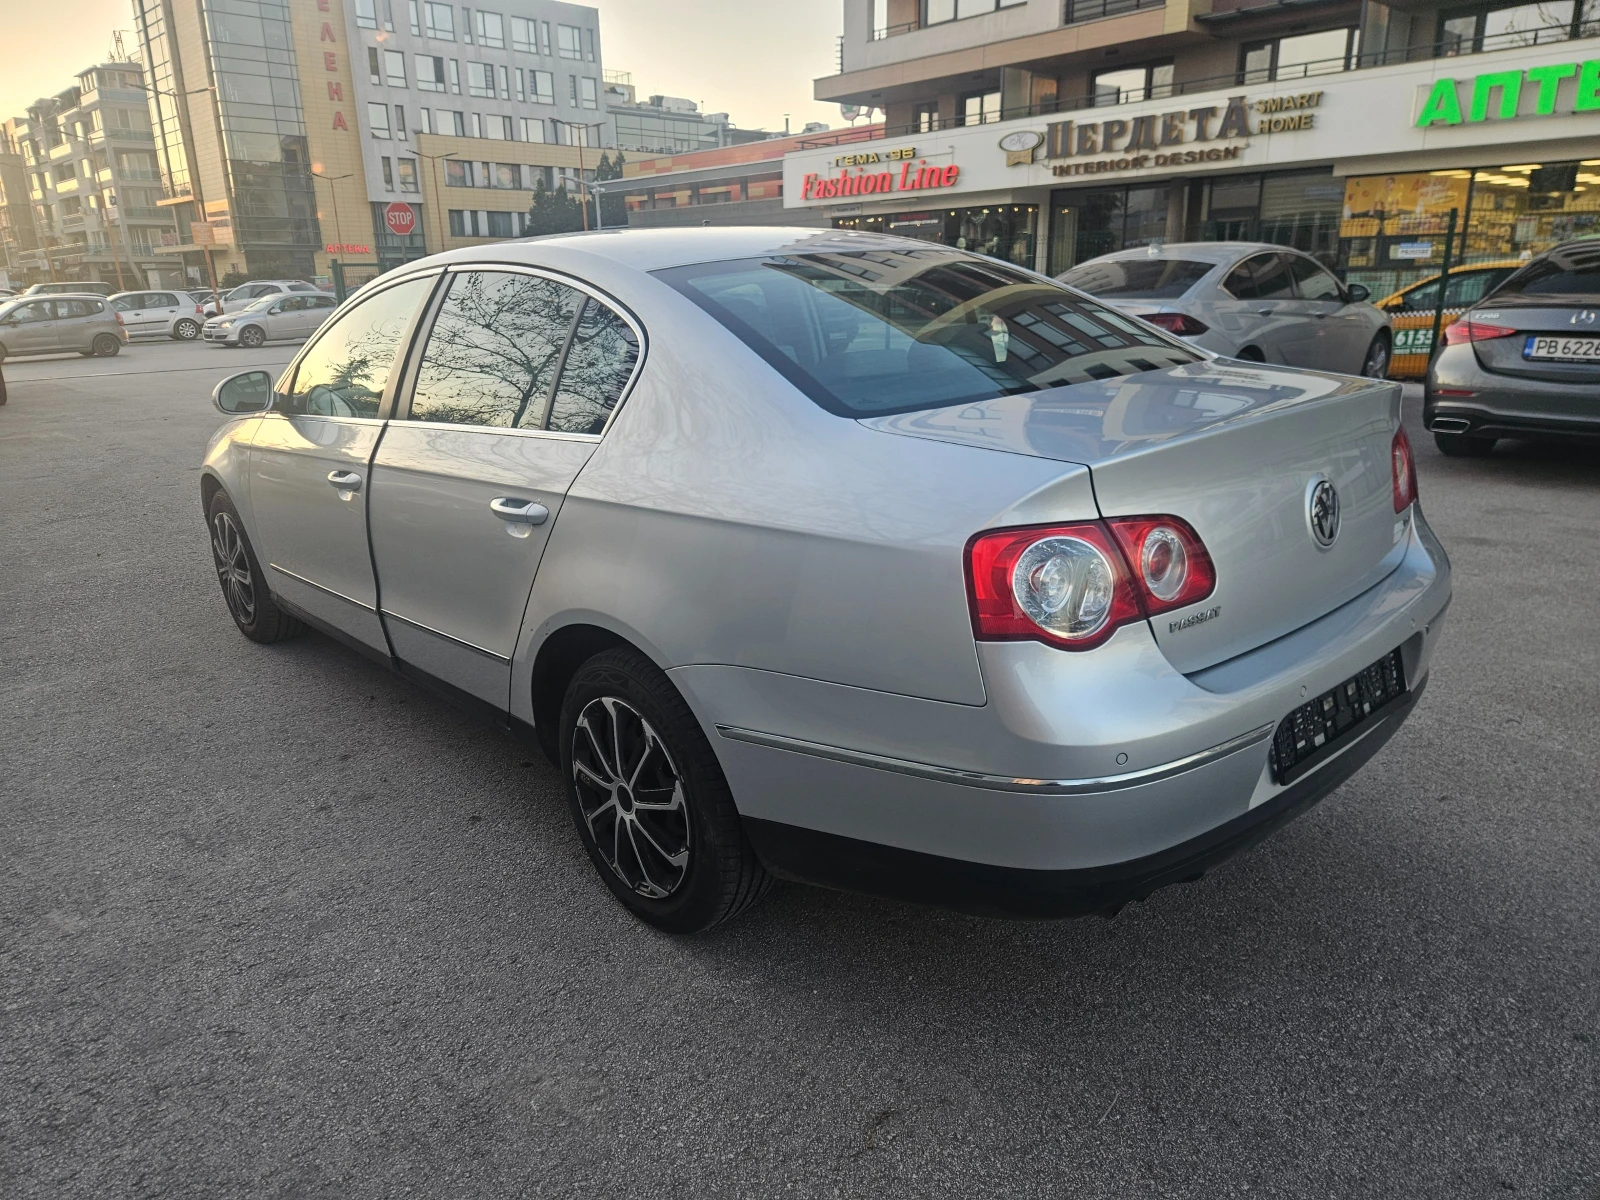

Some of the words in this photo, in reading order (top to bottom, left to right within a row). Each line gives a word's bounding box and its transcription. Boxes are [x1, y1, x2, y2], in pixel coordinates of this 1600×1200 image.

[1255, 91, 1324, 114] SMART
[1046, 95, 1250, 160] ПЕРДЕТА
[1257, 113, 1315, 134] HOME
[1052, 154, 1149, 177] INTERIOR
[1154, 145, 1240, 167] DESIGN
[800, 167, 892, 200] Fashion
[897, 159, 959, 191] Line
[388, 211, 413, 225] STOP
[326, 244, 370, 254] АПТЕКА
[1536, 339, 1559, 355] PB
[1169, 605, 1222, 633] PASSAT
